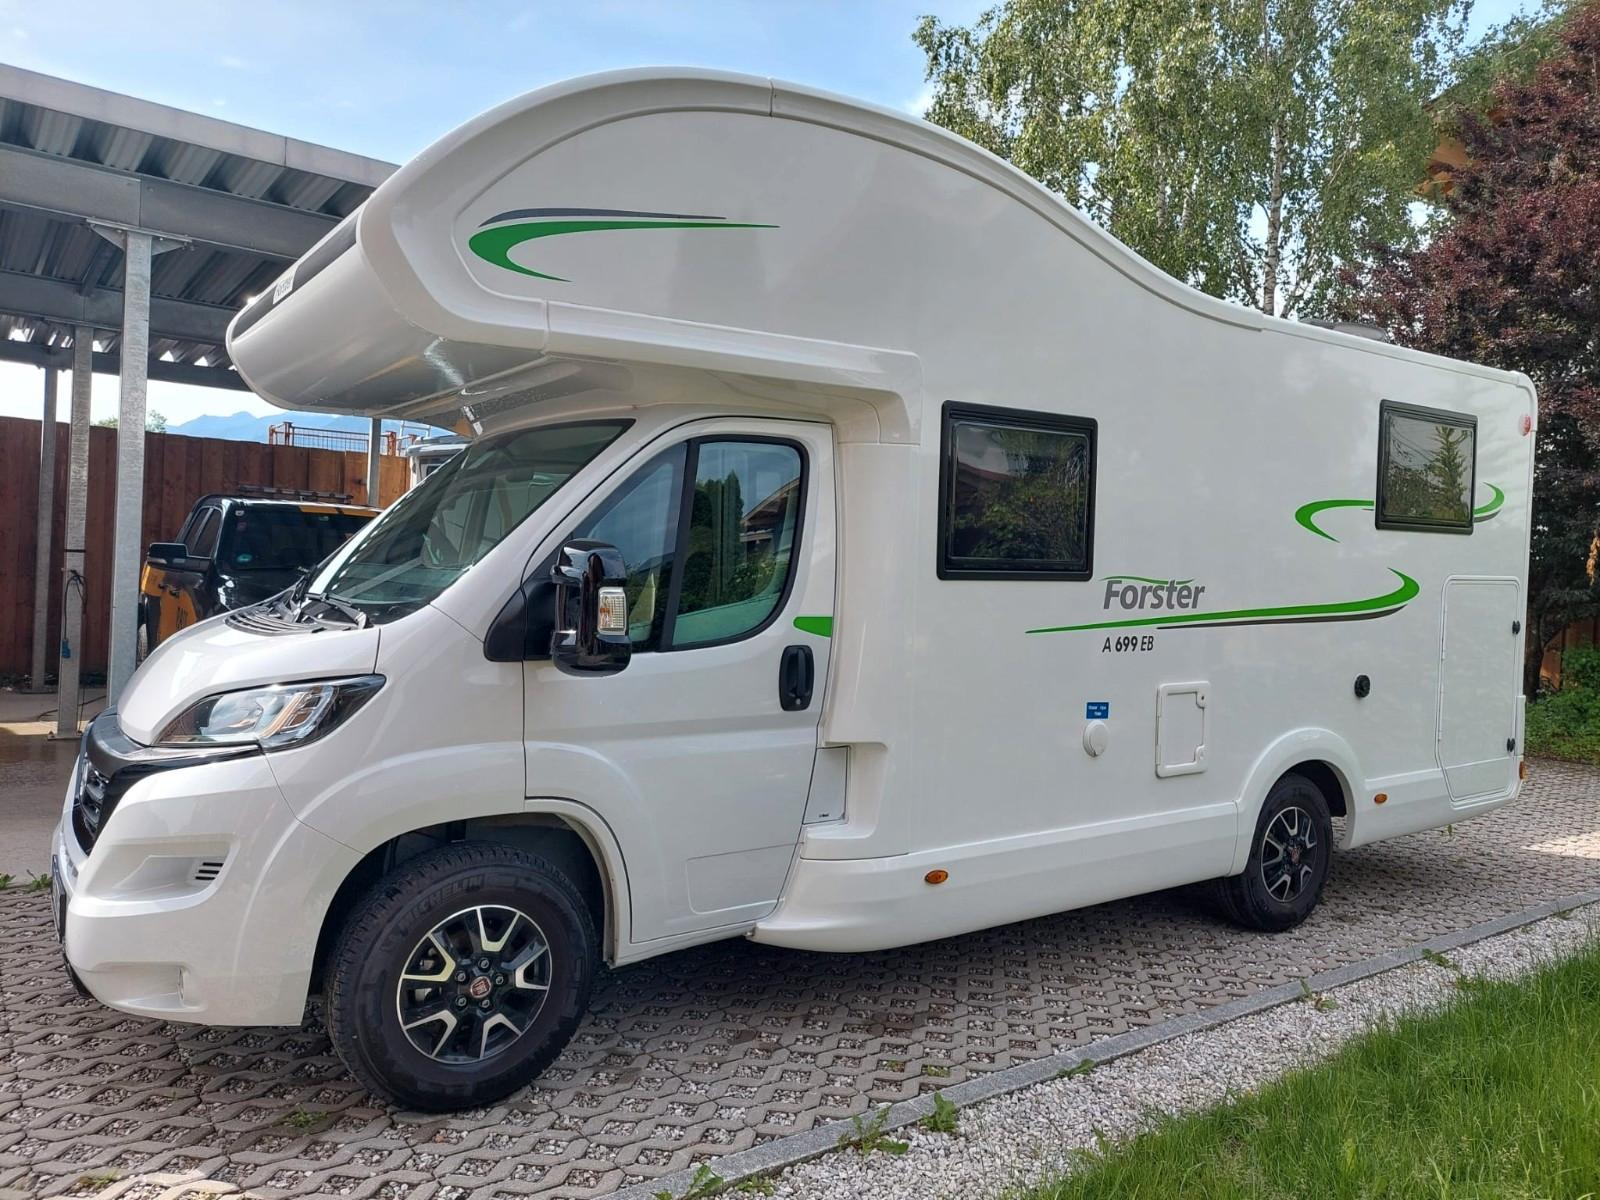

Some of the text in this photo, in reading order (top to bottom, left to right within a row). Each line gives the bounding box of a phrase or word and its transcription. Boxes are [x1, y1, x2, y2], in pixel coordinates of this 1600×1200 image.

[1103, 579, 1205, 609] Forster
[1102, 635, 1154, 653] A 699 EB
